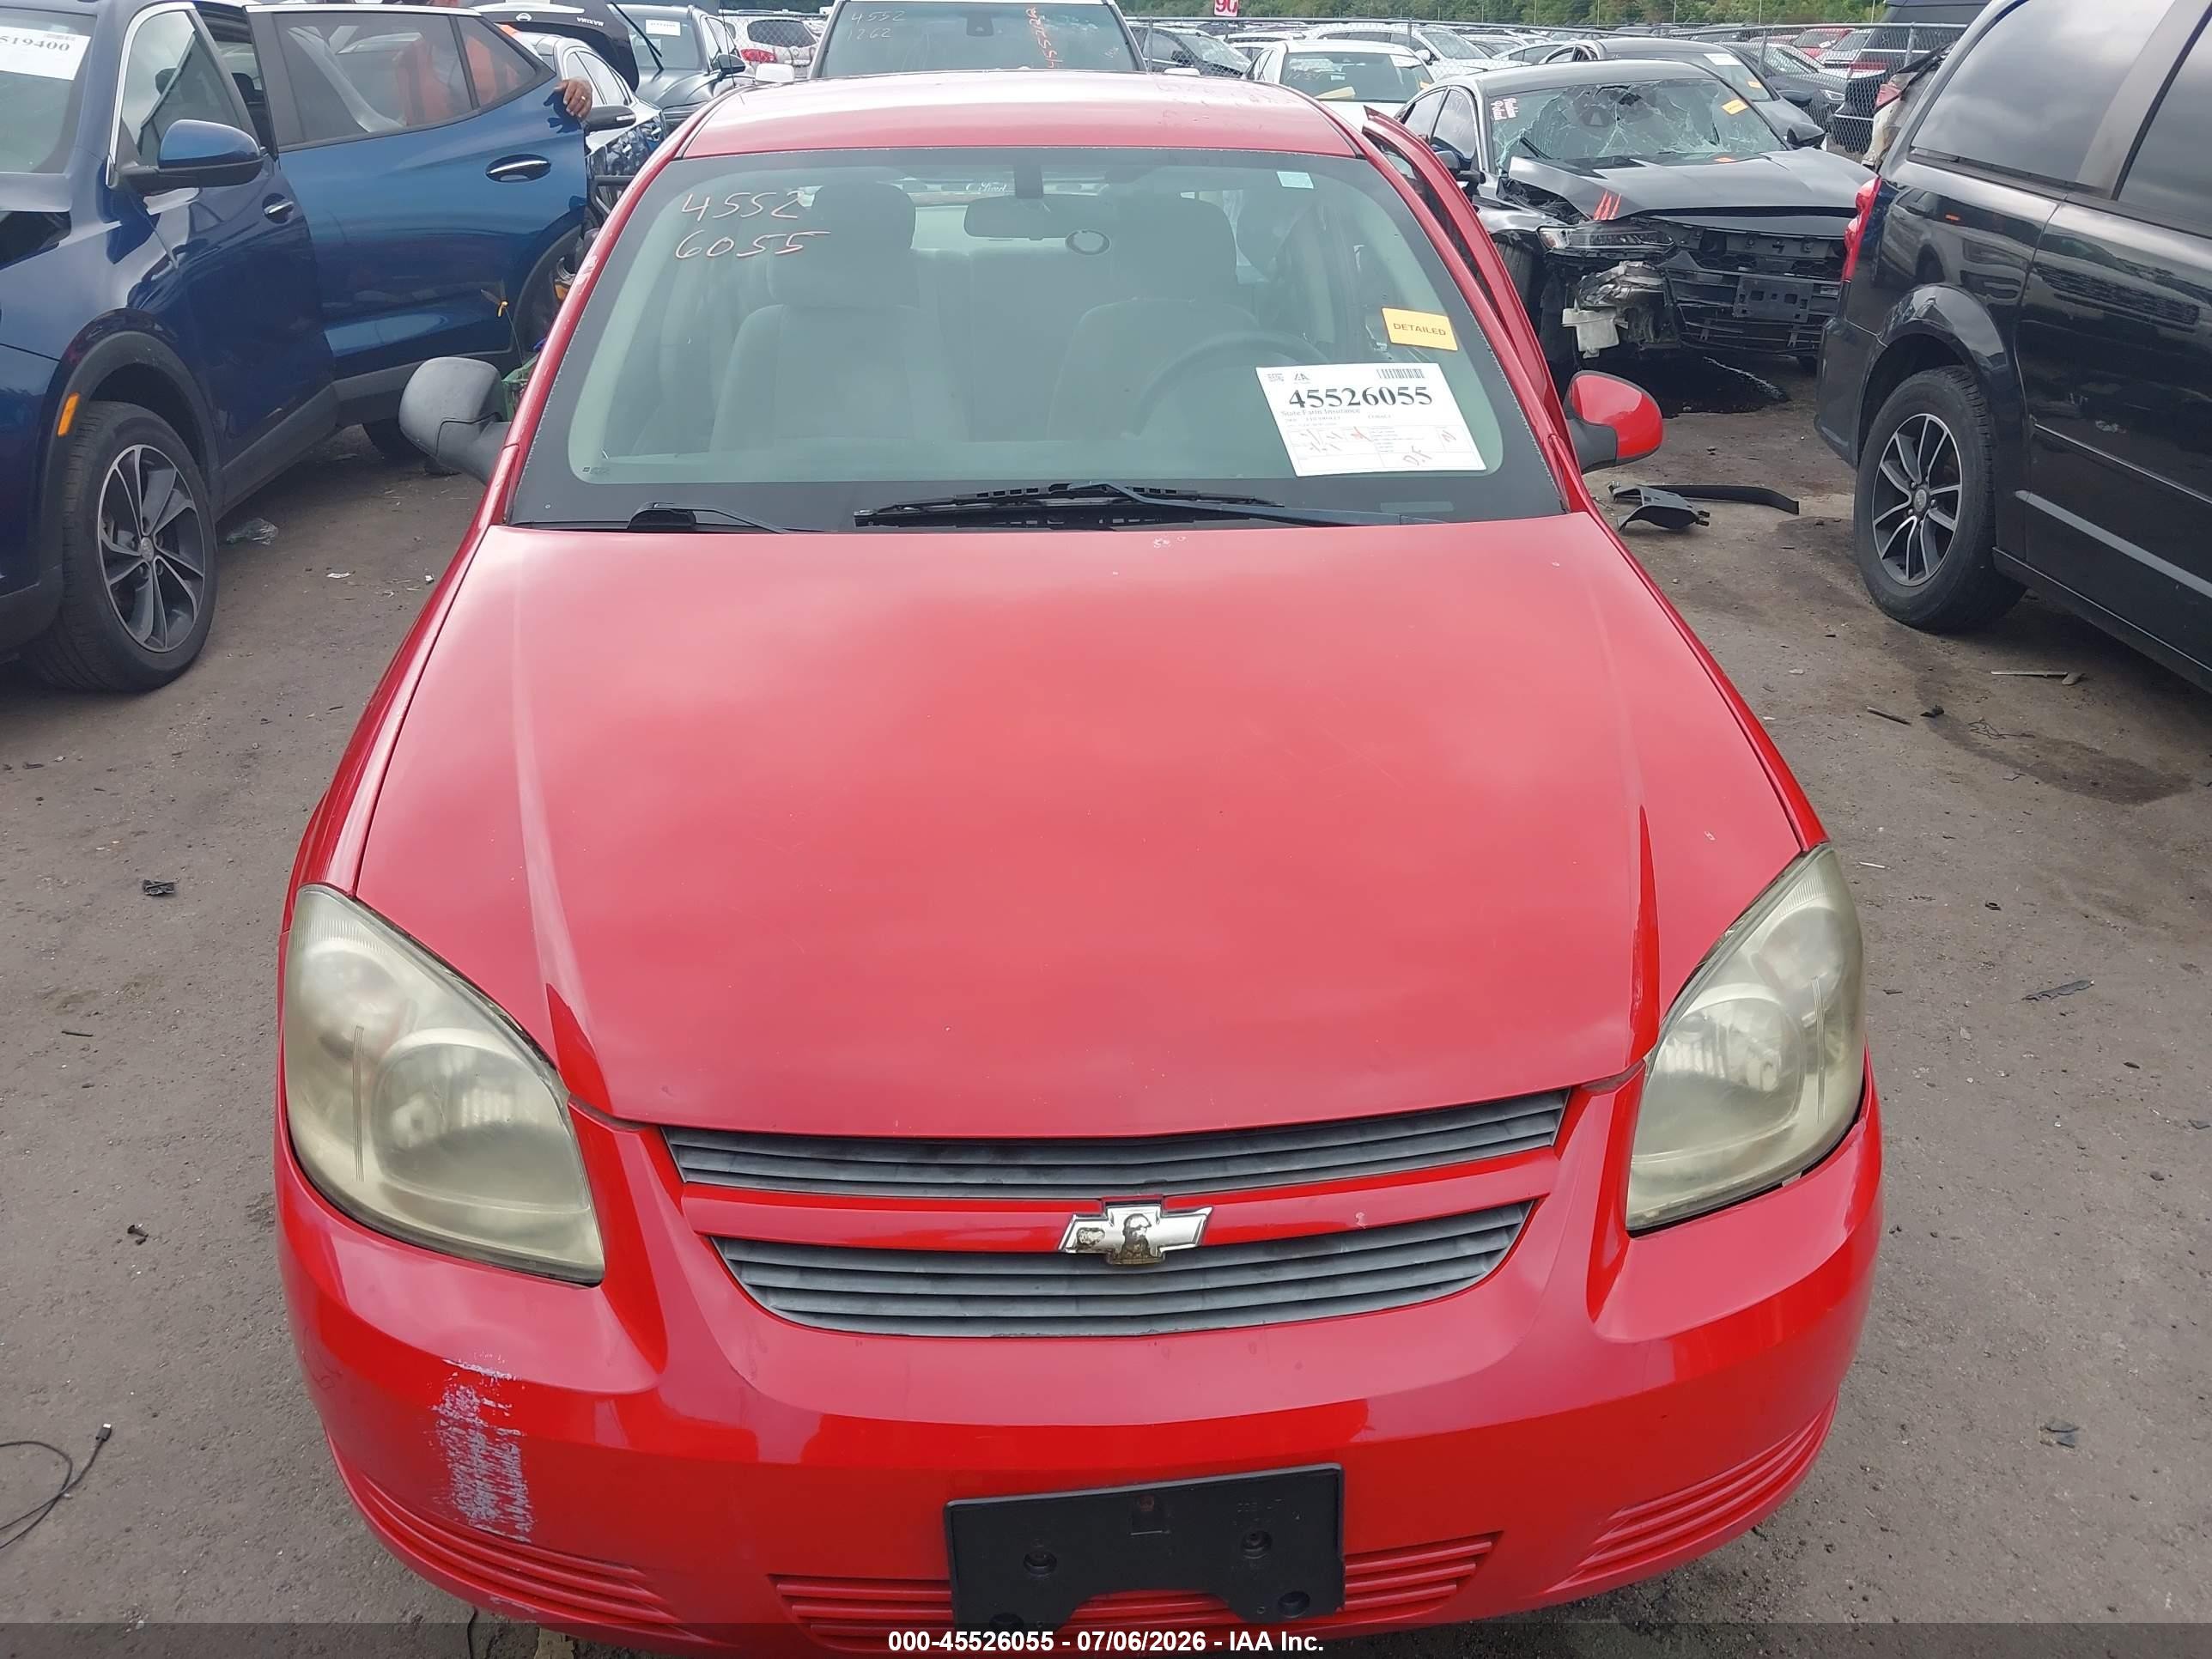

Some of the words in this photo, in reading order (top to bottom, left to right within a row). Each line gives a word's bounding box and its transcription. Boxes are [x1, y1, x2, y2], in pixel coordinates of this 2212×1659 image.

[681, 190, 804, 222] 4552
[675, 229, 831, 259] 6055
[1393, 322, 1447, 336] DETAILED
[1289, 386, 1433, 408] 45526055
